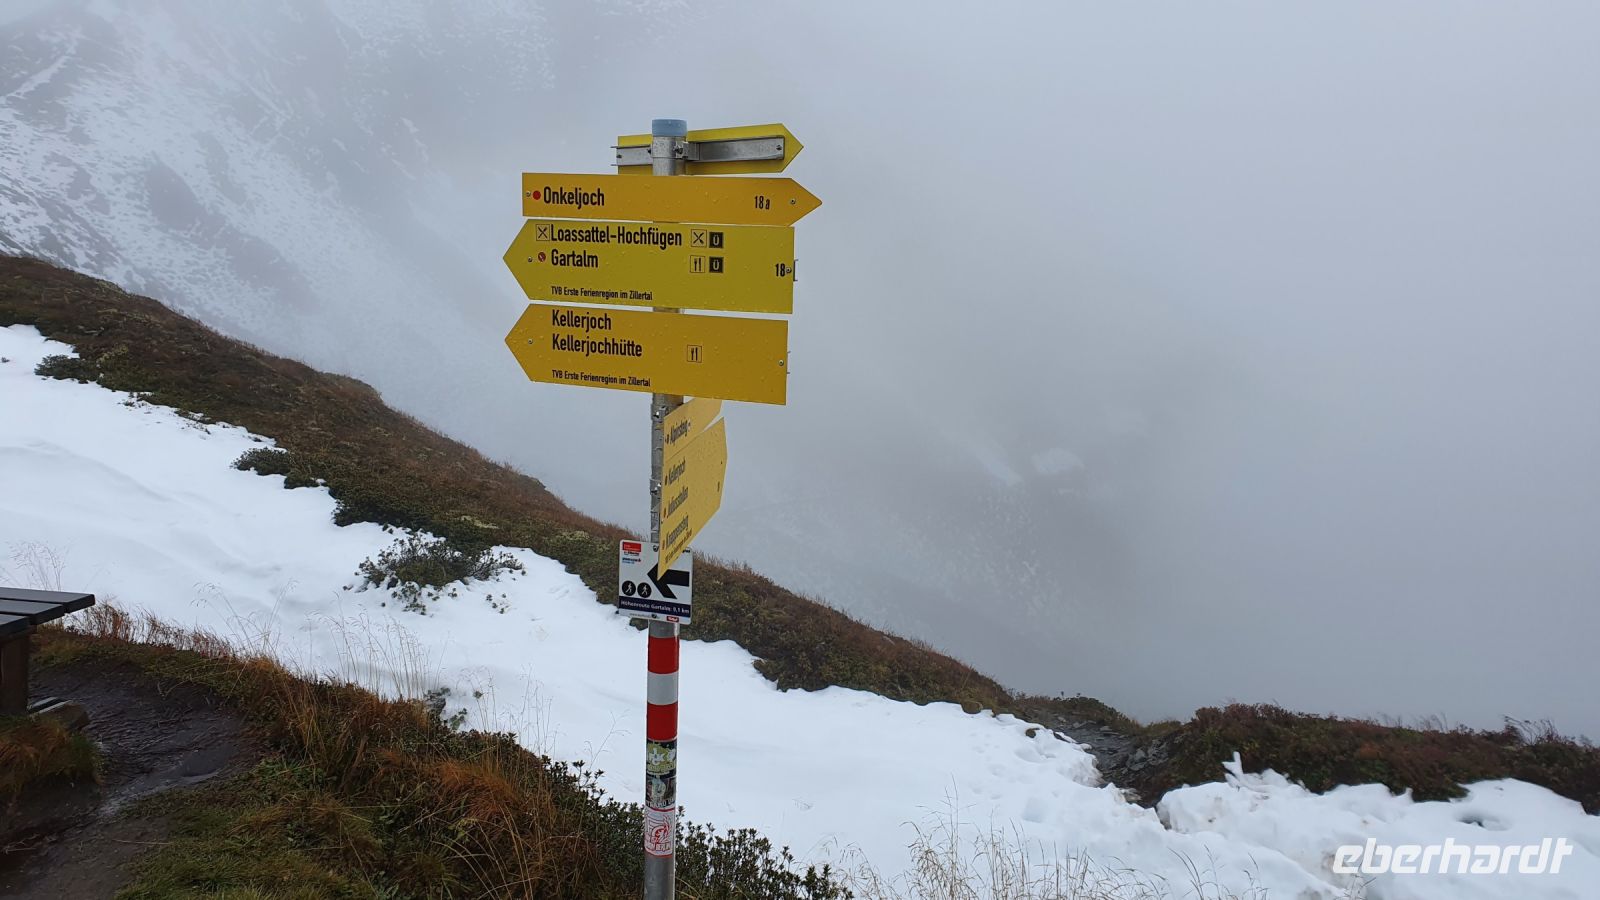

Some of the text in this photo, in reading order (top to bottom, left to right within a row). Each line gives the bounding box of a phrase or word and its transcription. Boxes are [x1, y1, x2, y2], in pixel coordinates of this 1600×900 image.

[543, 186, 604, 209] Onkeljoch
[551, 223, 682, 250] Loassattel-Hochfügen
[551, 249, 599, 268] Gartalm
[551, 286, 653, 301] TVB Erste Ferienregion im Zillertal
[552, 309, 611, 332] Kellerjoch
[552, 333, 642, 357] Kellerjochhütte
[552, 369, 651, 388] TVB Erste Ferienregion im Zillertal
